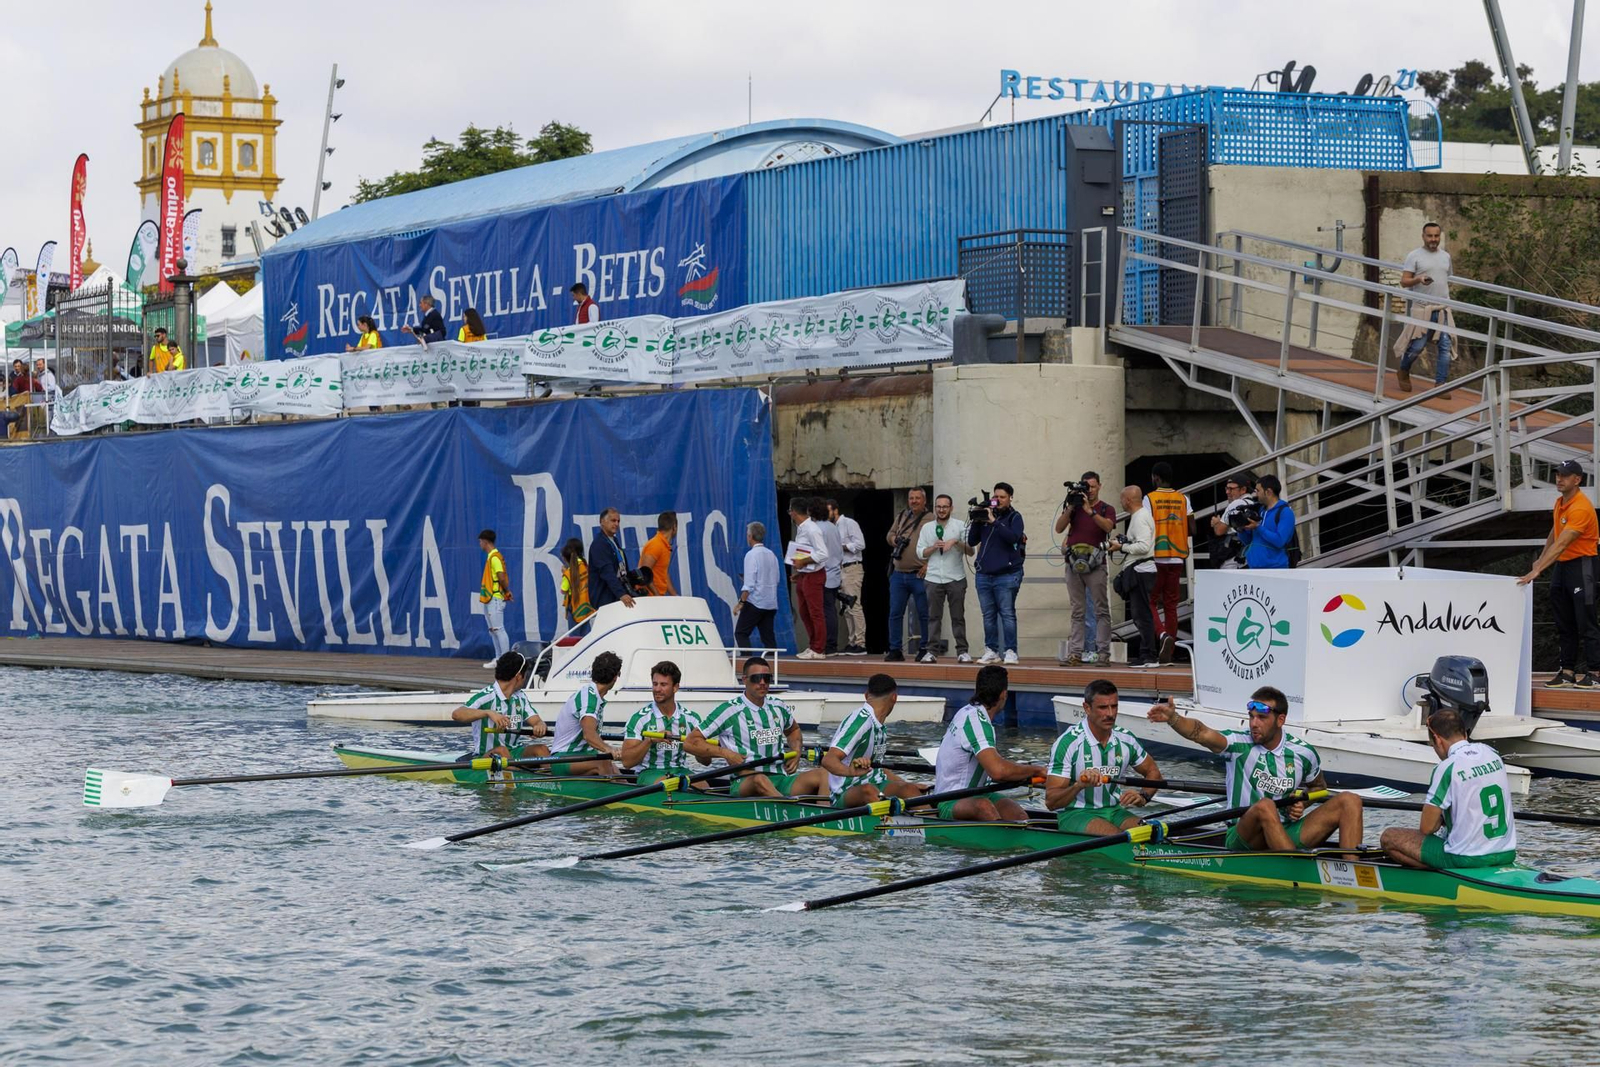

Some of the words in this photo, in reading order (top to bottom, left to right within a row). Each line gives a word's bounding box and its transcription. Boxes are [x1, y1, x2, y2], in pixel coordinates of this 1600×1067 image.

[1001, 69, 1245, 102] RESTAURA
[162, 176, 180, 280] Cruzcampo
[316, 283, 420, 339] REGATA
[429, 265, 547, 323] SEVILLA
[573, 242, 665, 306] BETIS
[0, 498, 186, 638] REGATA
[203, 483, 461, 649] SEVILLA
[1222, 584, 1276, 617] FEDERACION
[1377, 600, 1506, 635] Andalucía
[661, 625, 708, 645] FISA
[1221, 648, 1254, 680] ANDALUZA
[1256, 653, 1275, 678] REMO
[750, 728, 782, 739] FOREVER
[757, 736, 778, 746] GREEN
[1253, 768, 1293, 788] FOREVER
[1257, 780, 1286, 795] GREEN
[753, 802, 789, 822] Luis
[1480, 784, 1508, 839] 9
[1333, 862, 1348, 872] IMD
